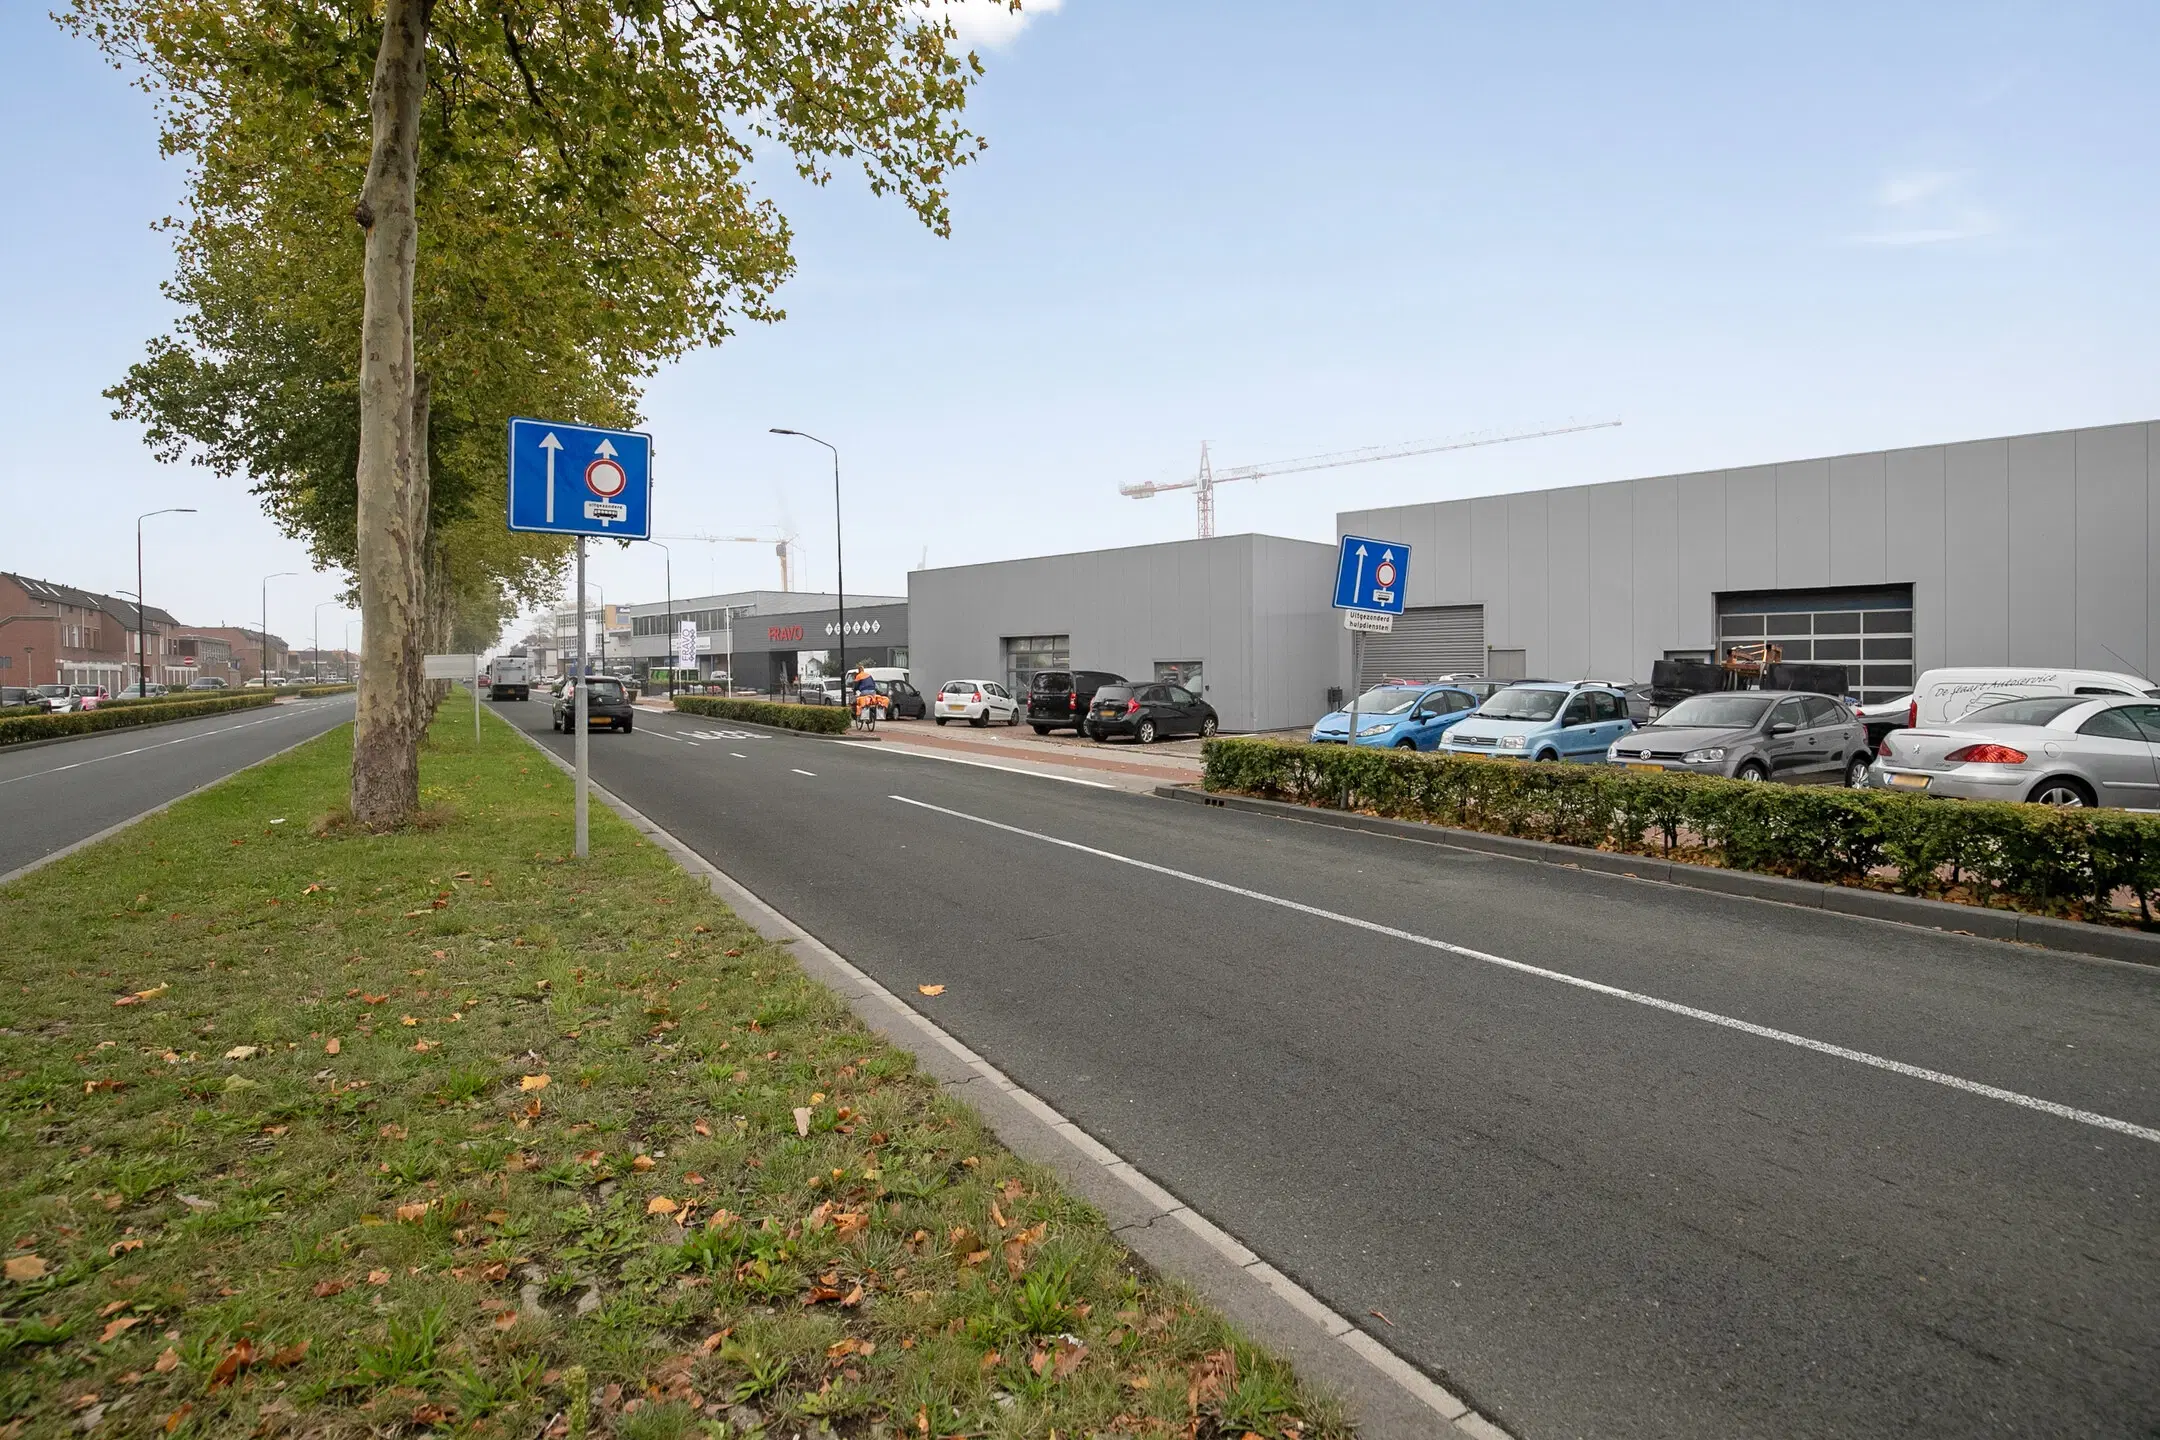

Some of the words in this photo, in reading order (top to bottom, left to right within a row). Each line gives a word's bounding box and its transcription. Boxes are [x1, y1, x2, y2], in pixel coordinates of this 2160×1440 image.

[1350, 611, 1390, 622] Uitgezonderd
[767, 625, 803, 641] FRAVO
[826, 621, 879, 634] TEGELS
[1349, 621, 1389, 631] hulpdiensten
[682, 629, 691, 661] FRAVO
[1935, 687, 1949, 698] De
[1986, 674, 2056, 690] Autoservice
